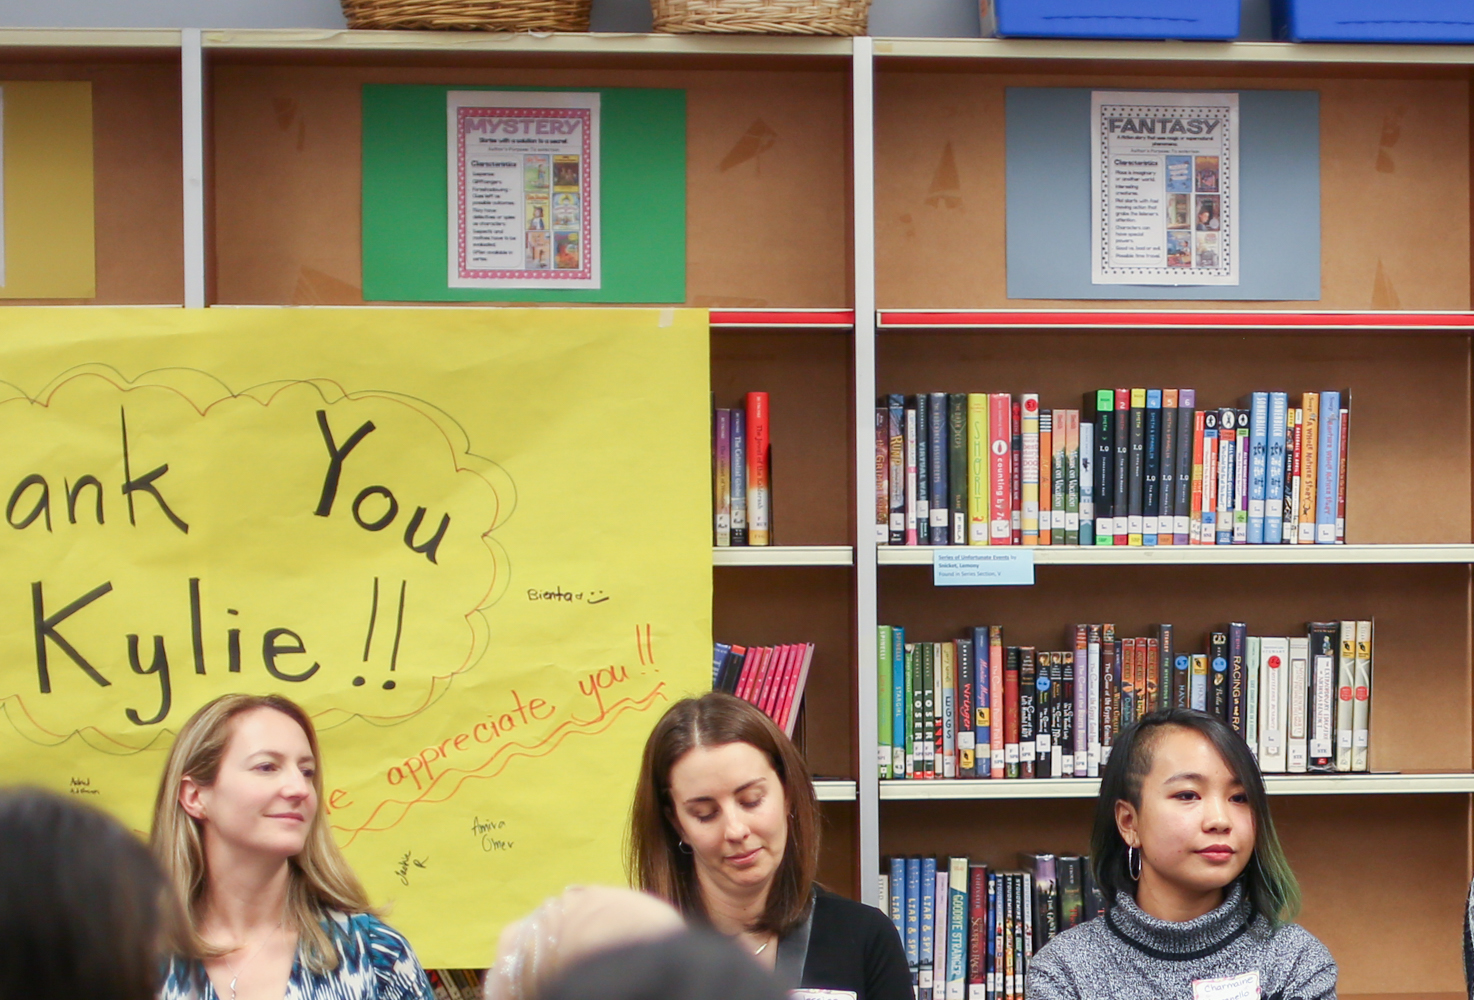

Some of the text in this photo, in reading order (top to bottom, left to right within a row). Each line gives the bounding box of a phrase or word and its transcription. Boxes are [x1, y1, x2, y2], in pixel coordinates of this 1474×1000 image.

[464, 118, 581, 135] MYSTERY
[1109, 118, 1220, 135] FANTASY
[312, 410, 450, 565] You
[996, 457, 1005, 509] counting by
[1232, 655, 1242, 698] RACING
[914, 690, 923, 740] LOSER
[924, 689, 933, 740] LOSER
[960, 682, 972, 731] Wringer
[387, 690, 556, 791] appreciate
[891, 895, 900, 920] LIAR
[907, 897, 917, 956] LIAR & SPY
[922, 895, 932, 954] LIAR & SPY
[951, 894, 964, 976] GOODBYE STRANGER
[1204, 976, 1254, 992] Charmaine
